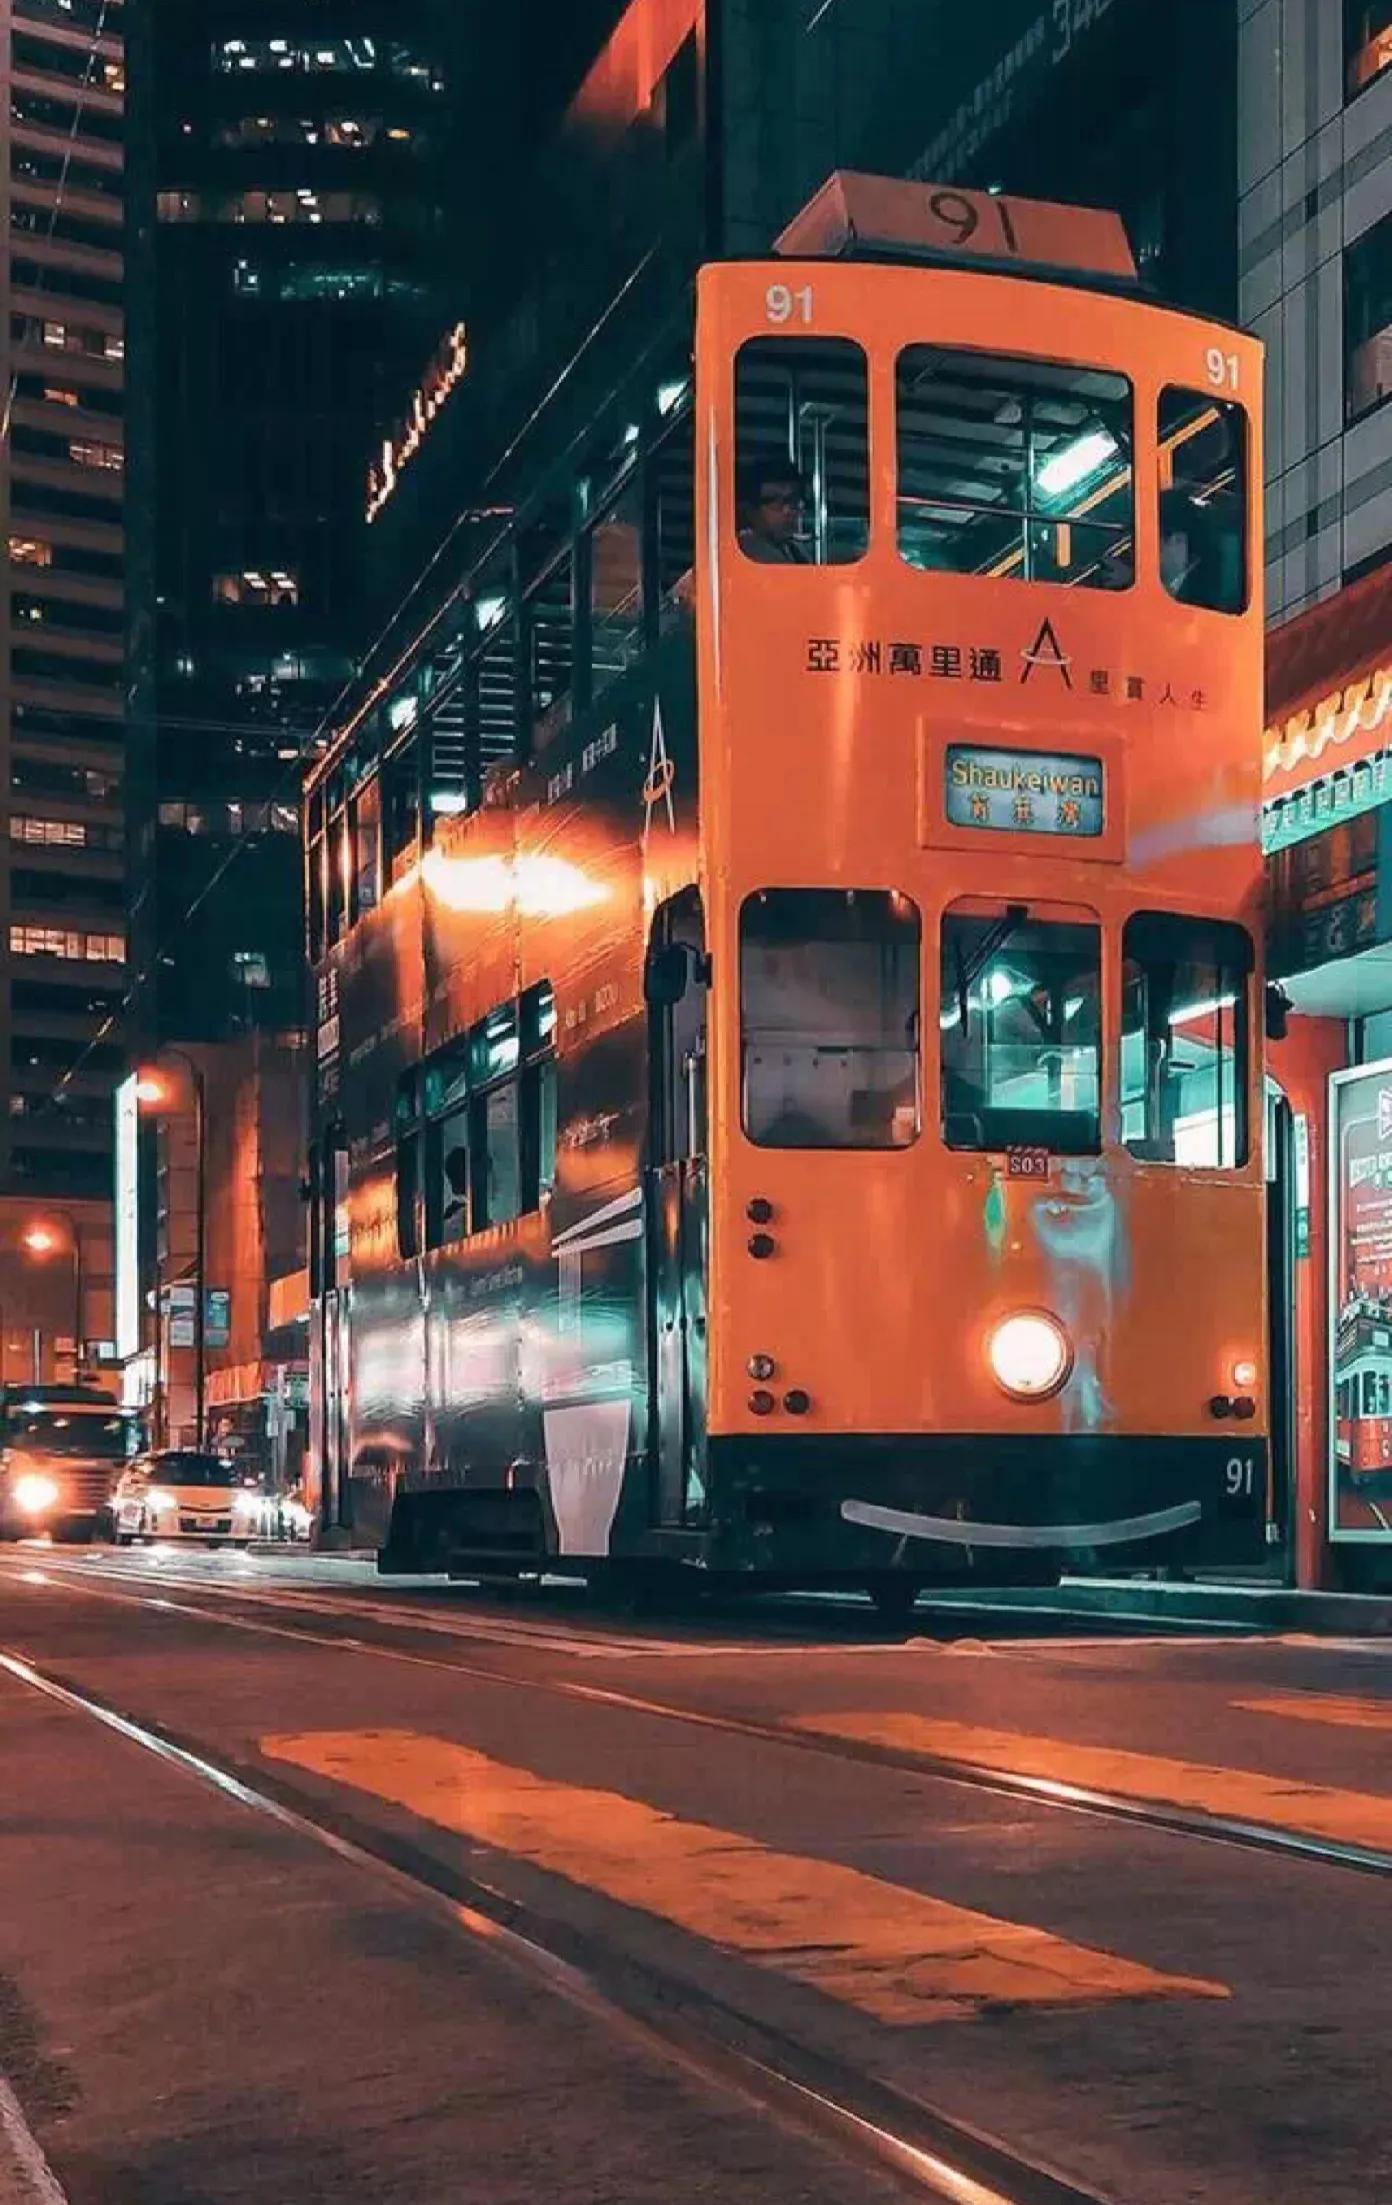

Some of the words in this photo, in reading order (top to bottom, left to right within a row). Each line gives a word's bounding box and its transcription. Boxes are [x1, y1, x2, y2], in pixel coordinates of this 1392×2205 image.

[930, 191, 1018, 254] 91
[765, 284, 813, 323] 91
[1206, 348, 1239, 391] 91
[806, 637, 1003, 683] 亞洲萬里通
[952, 758, 1099, 797] Shaukeiwan
[1226, 1457, 1253, 1495] 91
